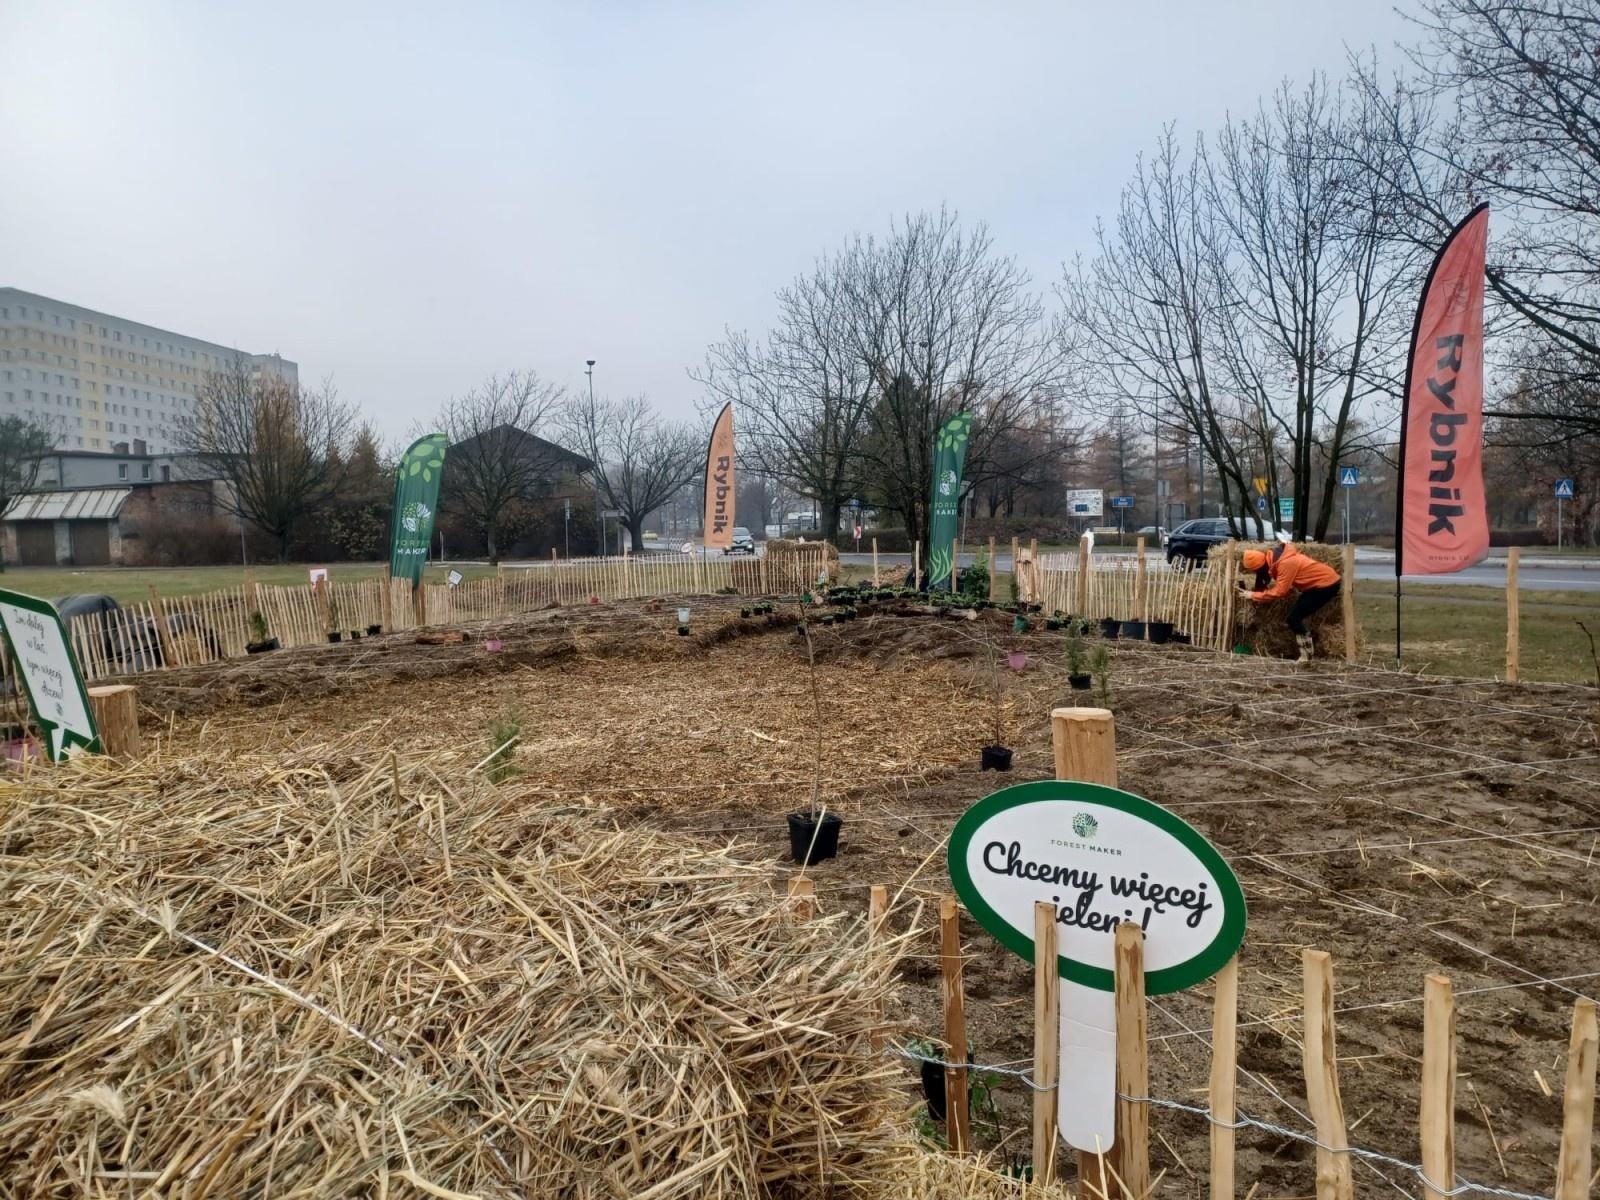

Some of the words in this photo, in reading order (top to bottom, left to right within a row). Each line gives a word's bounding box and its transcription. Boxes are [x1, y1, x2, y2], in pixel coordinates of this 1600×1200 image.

[1427, 334, 1468, 536] Rybnik
[713, 455, 731, 534] Rybnik
[983, 841, 1103, 902] Chcemy
[1110, 872, 1213, 928] więcej
[1050, 839, 1087, 850] FOREST
[1089, 845, 1122, 857] MAKER
